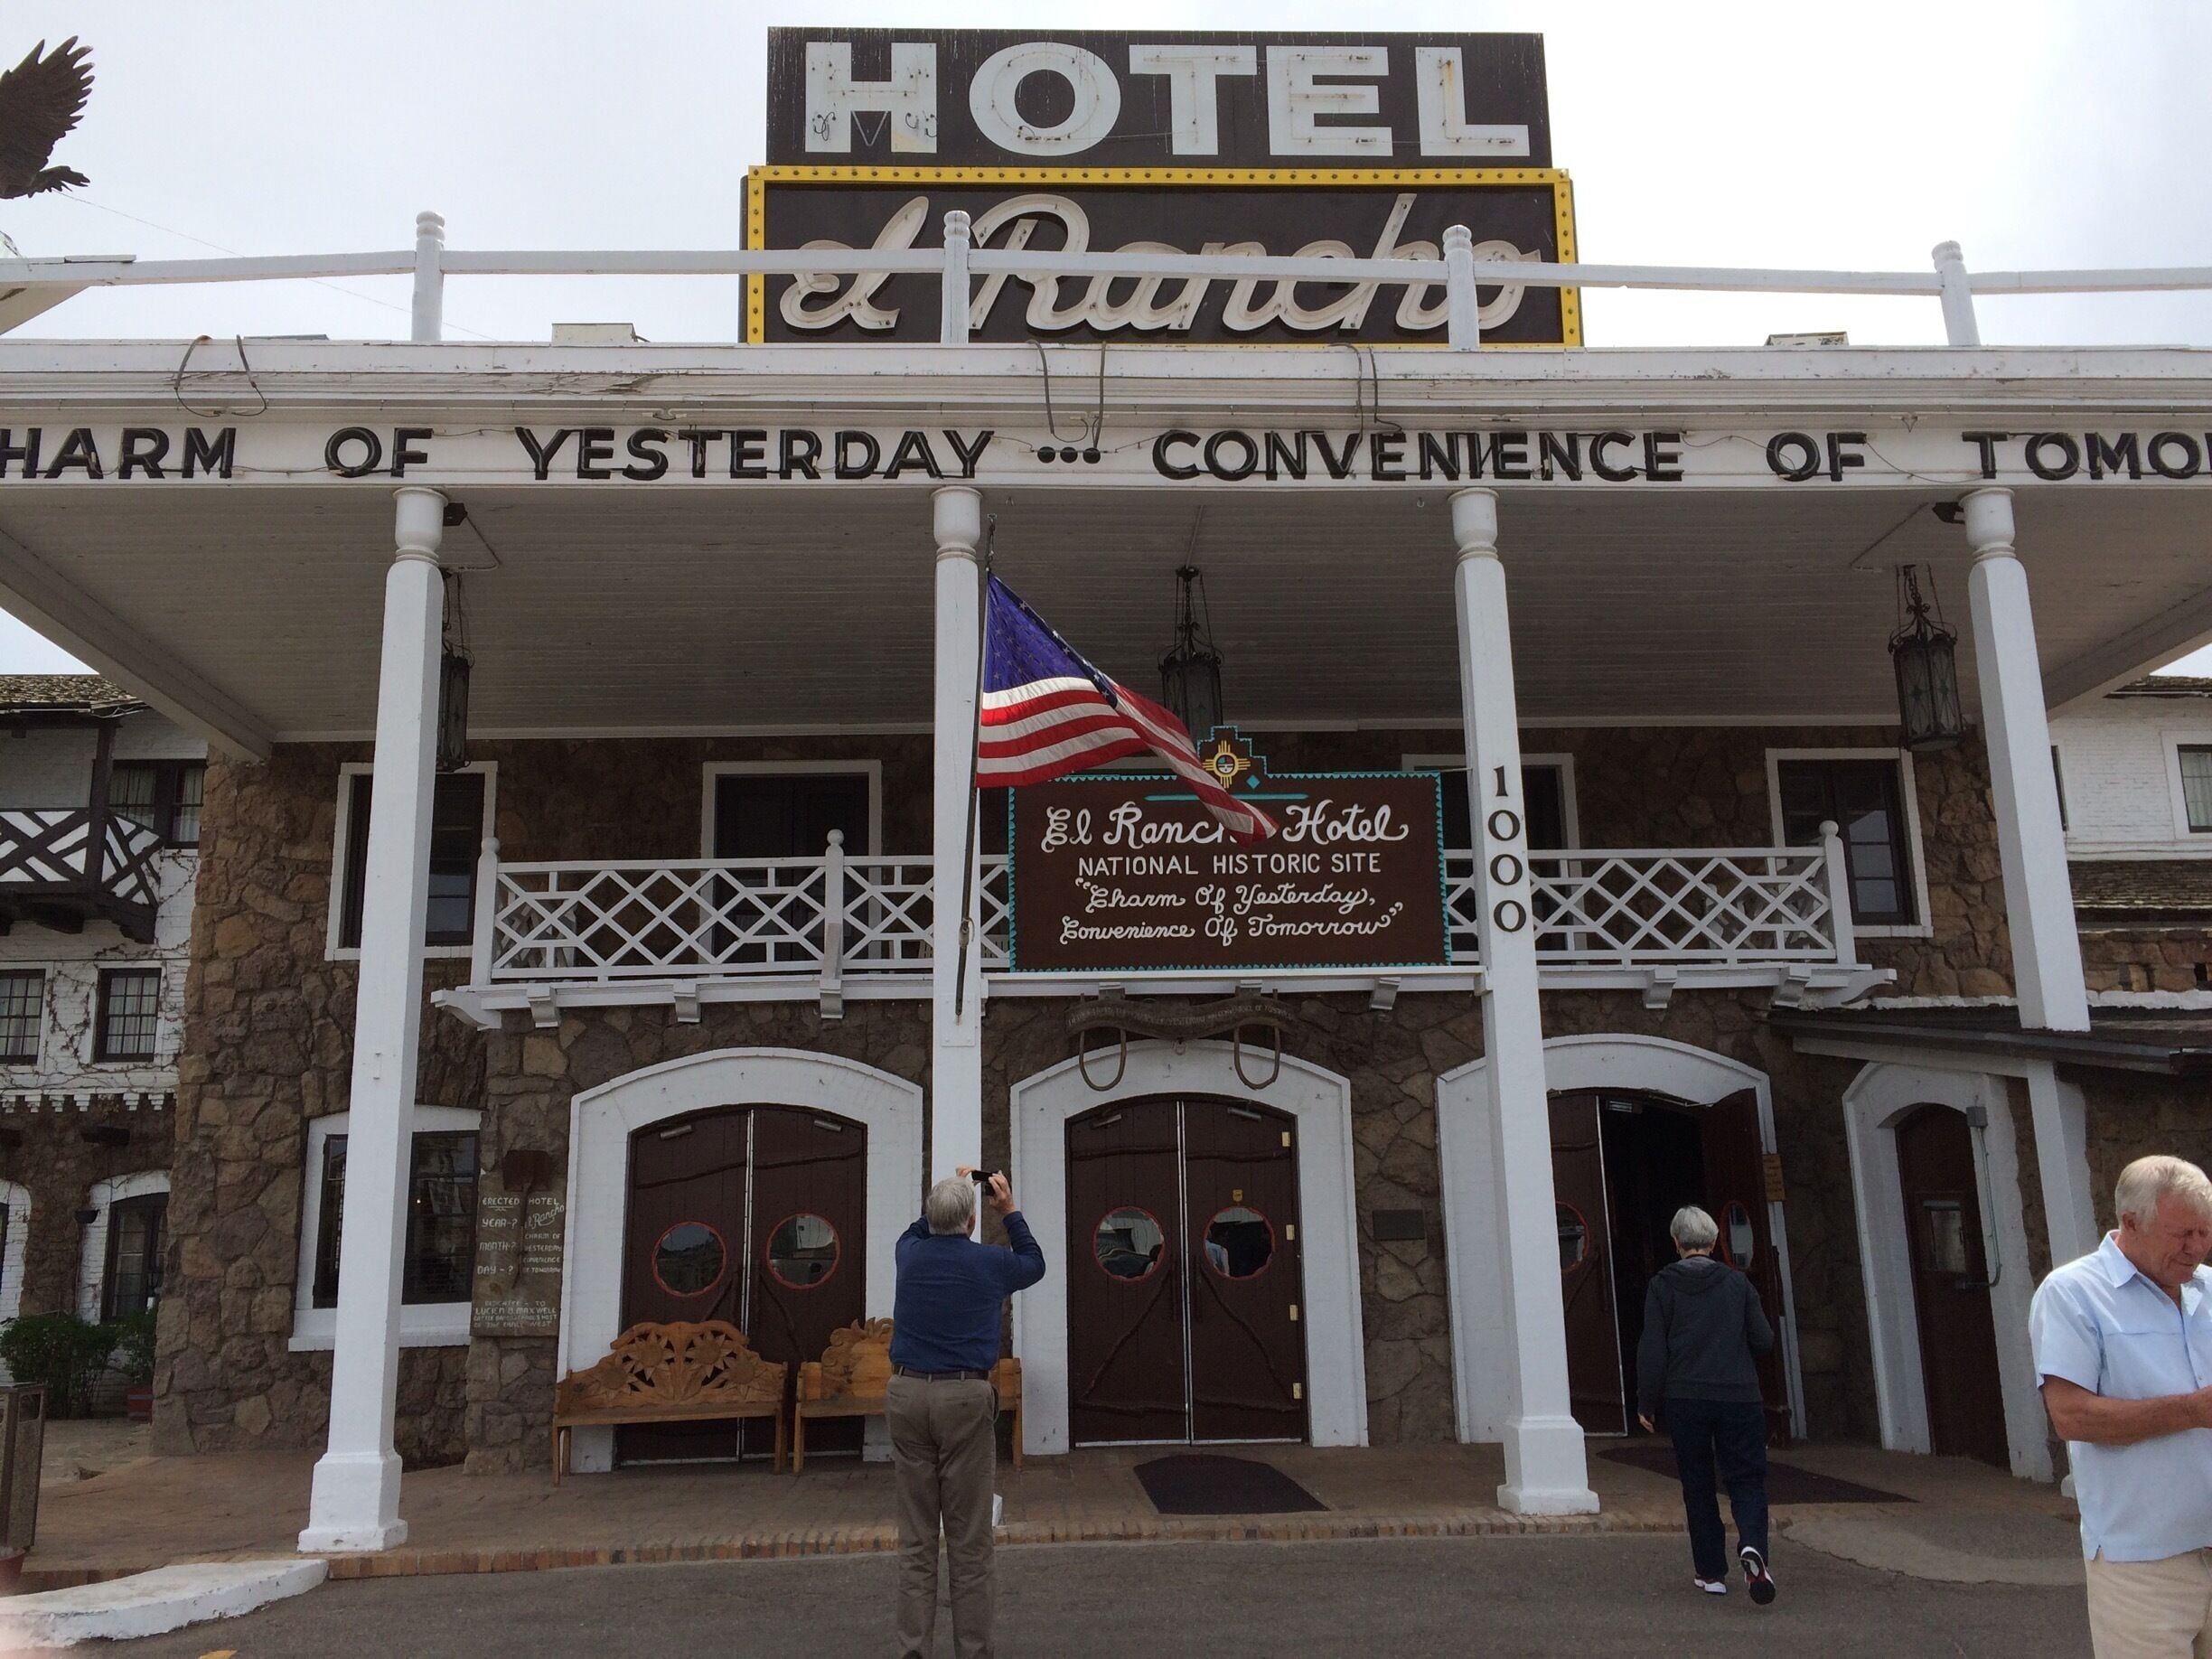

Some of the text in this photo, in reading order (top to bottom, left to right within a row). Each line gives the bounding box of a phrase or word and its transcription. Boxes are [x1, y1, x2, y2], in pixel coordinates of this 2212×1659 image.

[805, 42, 1530, 157] HOTEL
[969, 192, 1542, 331] Rancho
[0, 426, 237, 479] HARM
[324, 426, 434, 478] OF
[514, 427, 995, 481] YESTERDAY
[1152, 429, 1685, 482] CONVENIENCE
[1767, 432, 1867, 482] OF
[1962, 431, 2212, 482] TOMO
[1041, 799, 1409, 853] El Ranc Hotel
[1078, 852, 1382, 876] NATIONAL HISTORIC SITE
[1487, 765, 1527, 933] 1000
[1195, 884, 1226, 914] Of
[1233, 882, 1375, 914] Yesterday,
[1059, 915, 1195, 945] Convenience
[1204, 914, 1238, 947] Of
[482, 1197, 520, 1205] ERECTED
[528, 1197, 558, 1205] HOTEL
[477, 1265, 497, 1275] DAY
[475, 1308, 505, 1316] LUCIEN
